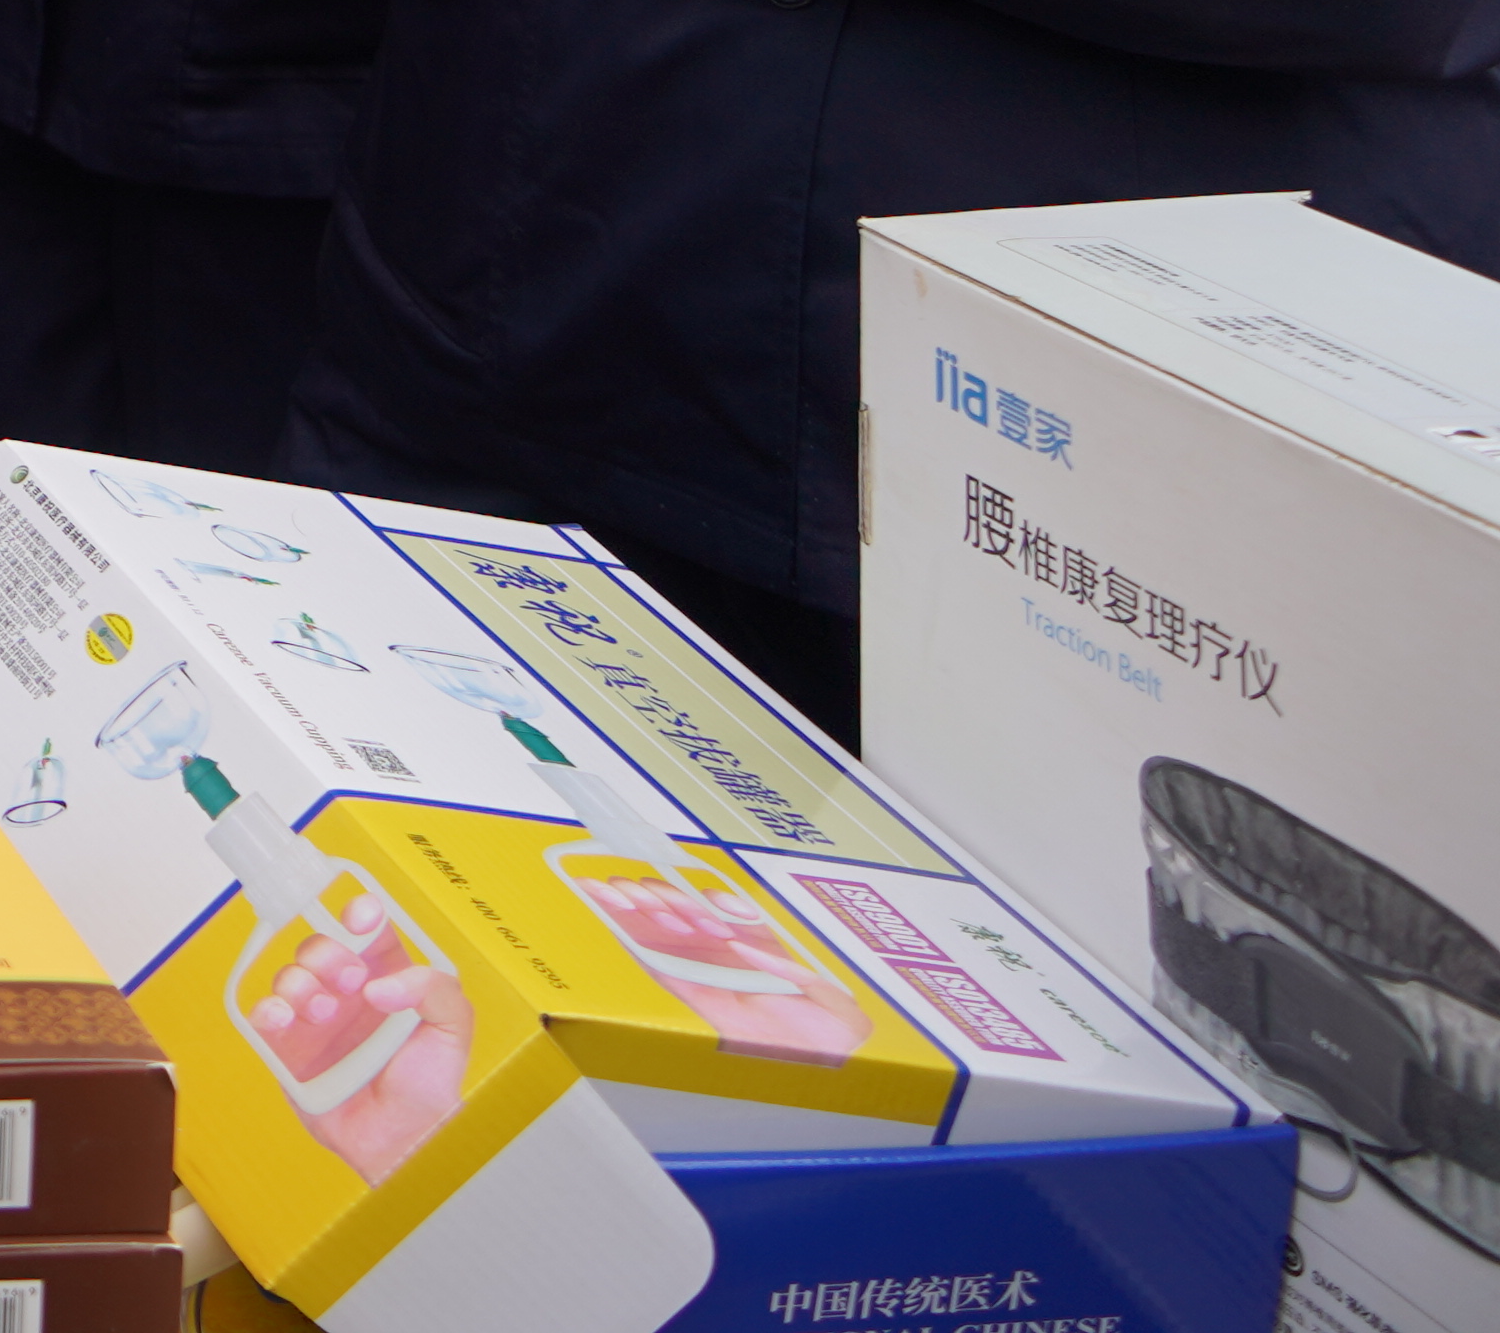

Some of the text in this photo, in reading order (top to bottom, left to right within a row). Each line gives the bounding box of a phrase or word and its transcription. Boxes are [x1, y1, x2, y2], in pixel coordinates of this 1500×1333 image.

[21, 478, 111, 574] 北京康祝医疗器械有限公司
[963, 473, 1284, 719] 腰椎康复理疗仪
[1021, 596, 1163, 703] Traction Belt
[298, 717, 355, 777] Cupping
[833, 881, 940, 958] ISO9001
[527, 956, 570, 991] 9595
[927, 968, 1046, 1052] ISO13485
[768, 1269, 1040, 1324] 中国传统医术
